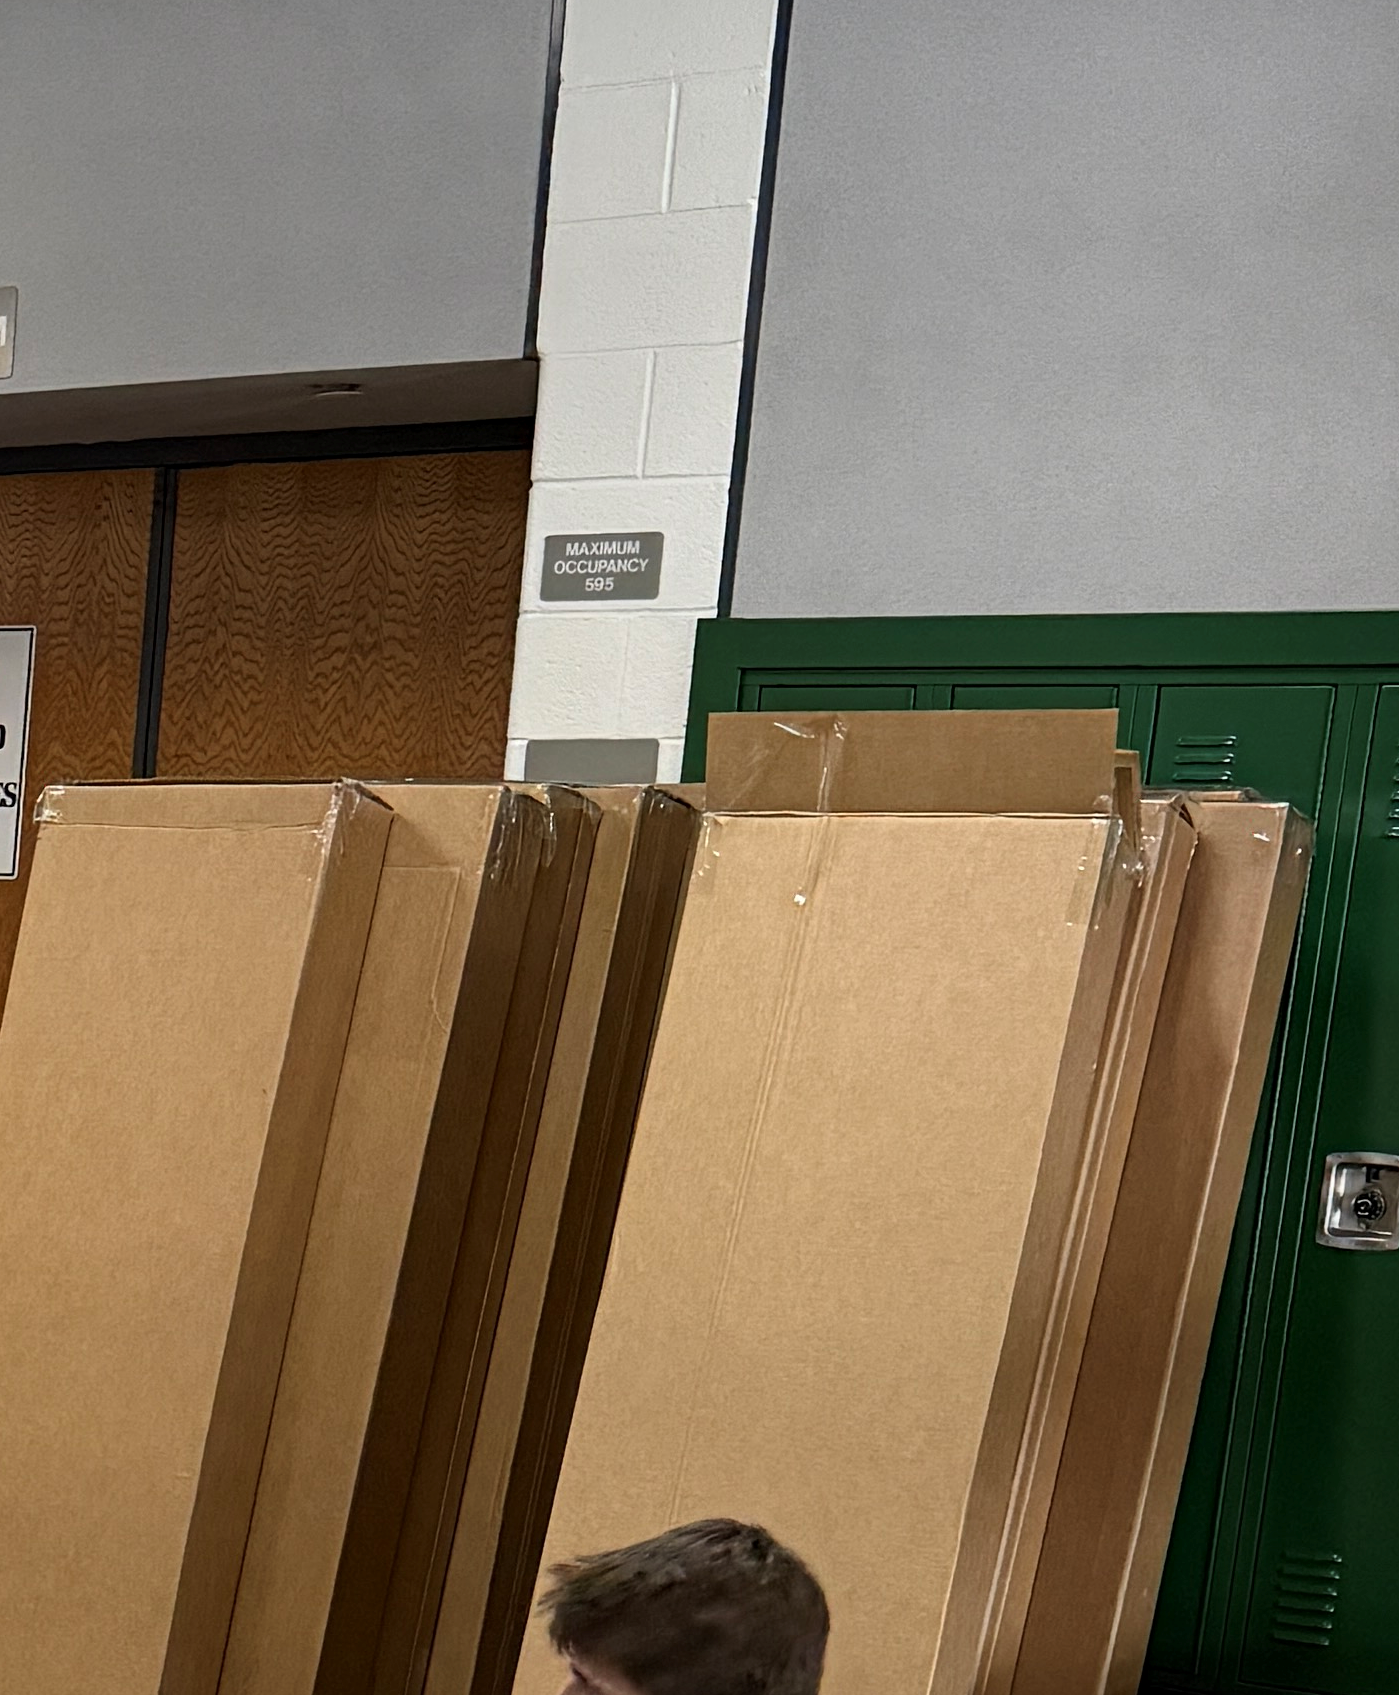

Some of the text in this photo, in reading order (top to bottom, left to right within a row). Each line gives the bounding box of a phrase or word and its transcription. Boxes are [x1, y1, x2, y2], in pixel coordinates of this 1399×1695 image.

[565, 540, 640, 556] MAXIMUM
[553, 558, 649, 574] OCCUPANCY
[584, 577, 614, 591] 595
